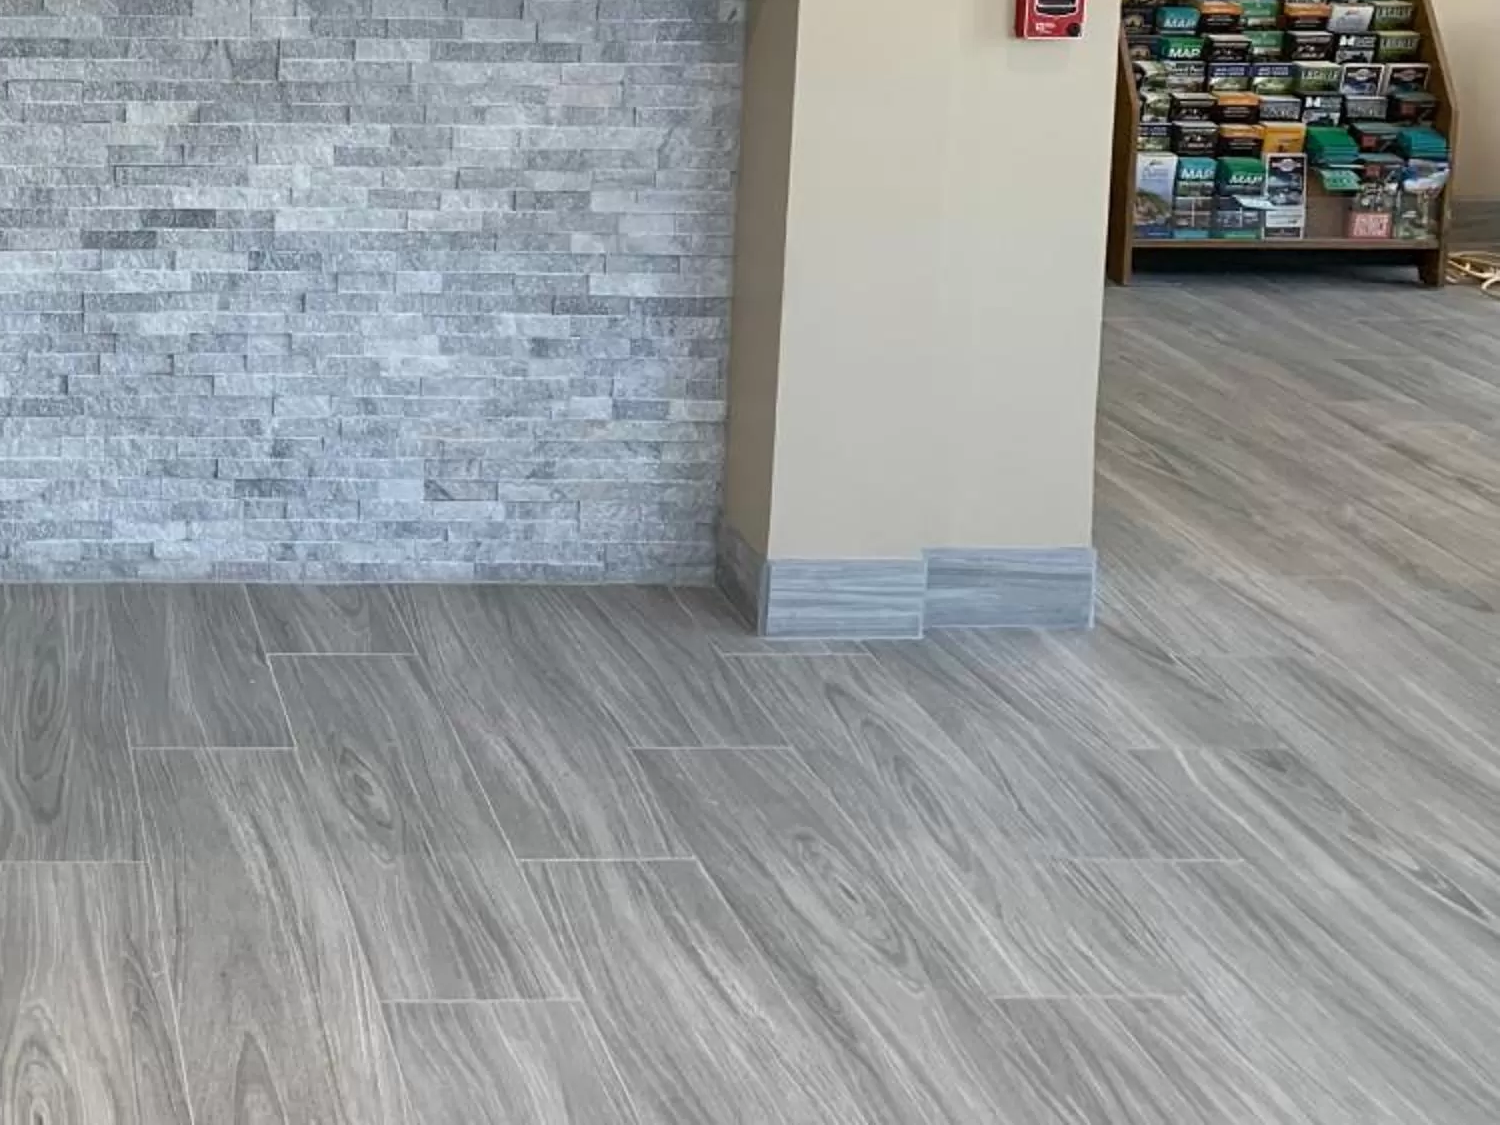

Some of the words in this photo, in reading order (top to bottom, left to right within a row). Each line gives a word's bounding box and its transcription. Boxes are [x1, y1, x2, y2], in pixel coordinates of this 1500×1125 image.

[1167, 47, 1202, 59] MAP
[1181, 168, 1215, 180] MAP
[1229, 174, 1263, 184] MAP
